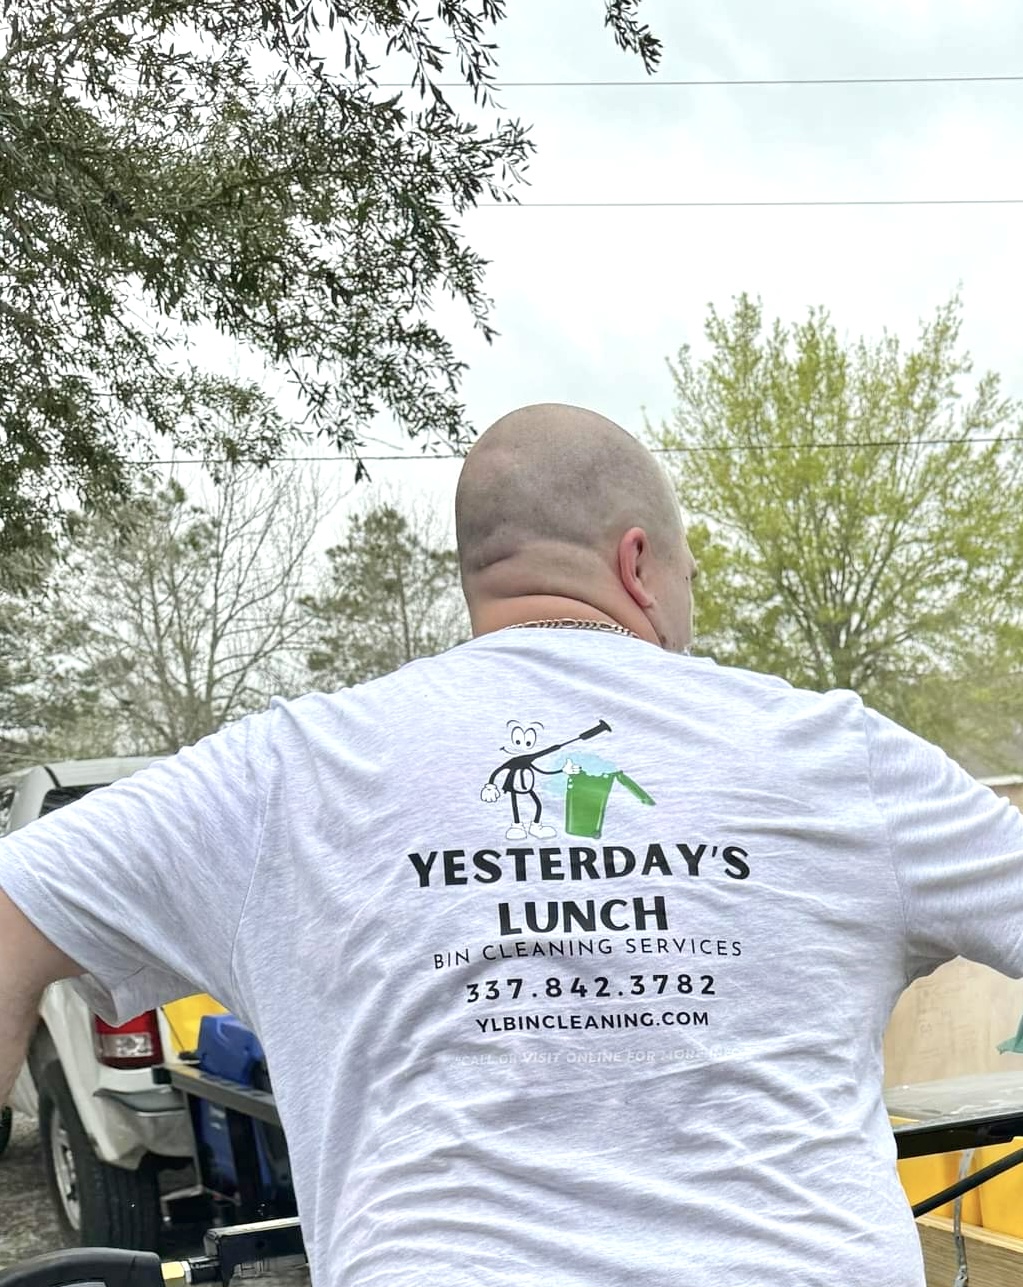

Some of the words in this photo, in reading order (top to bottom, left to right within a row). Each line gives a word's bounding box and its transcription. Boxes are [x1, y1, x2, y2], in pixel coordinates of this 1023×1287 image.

[407, 843, 751, 888] YESTERDAY'S
[498, 895, 669, 936] LUNCH
[433, 948, 470, 970] BIN
[482, 938, 613, 961] CLEANING
[625, 938, 743, 957] SERVICES
[466, 973, 716, 1003] 337.842.3782
[475, 1011, 709, 1033] YLBINCLEANING.COM
[521, 1051, 561, 1063] VISIT
[566, 1051, 622, 1064] ONLINE
[627, 1050, 656, 1062] FOR
